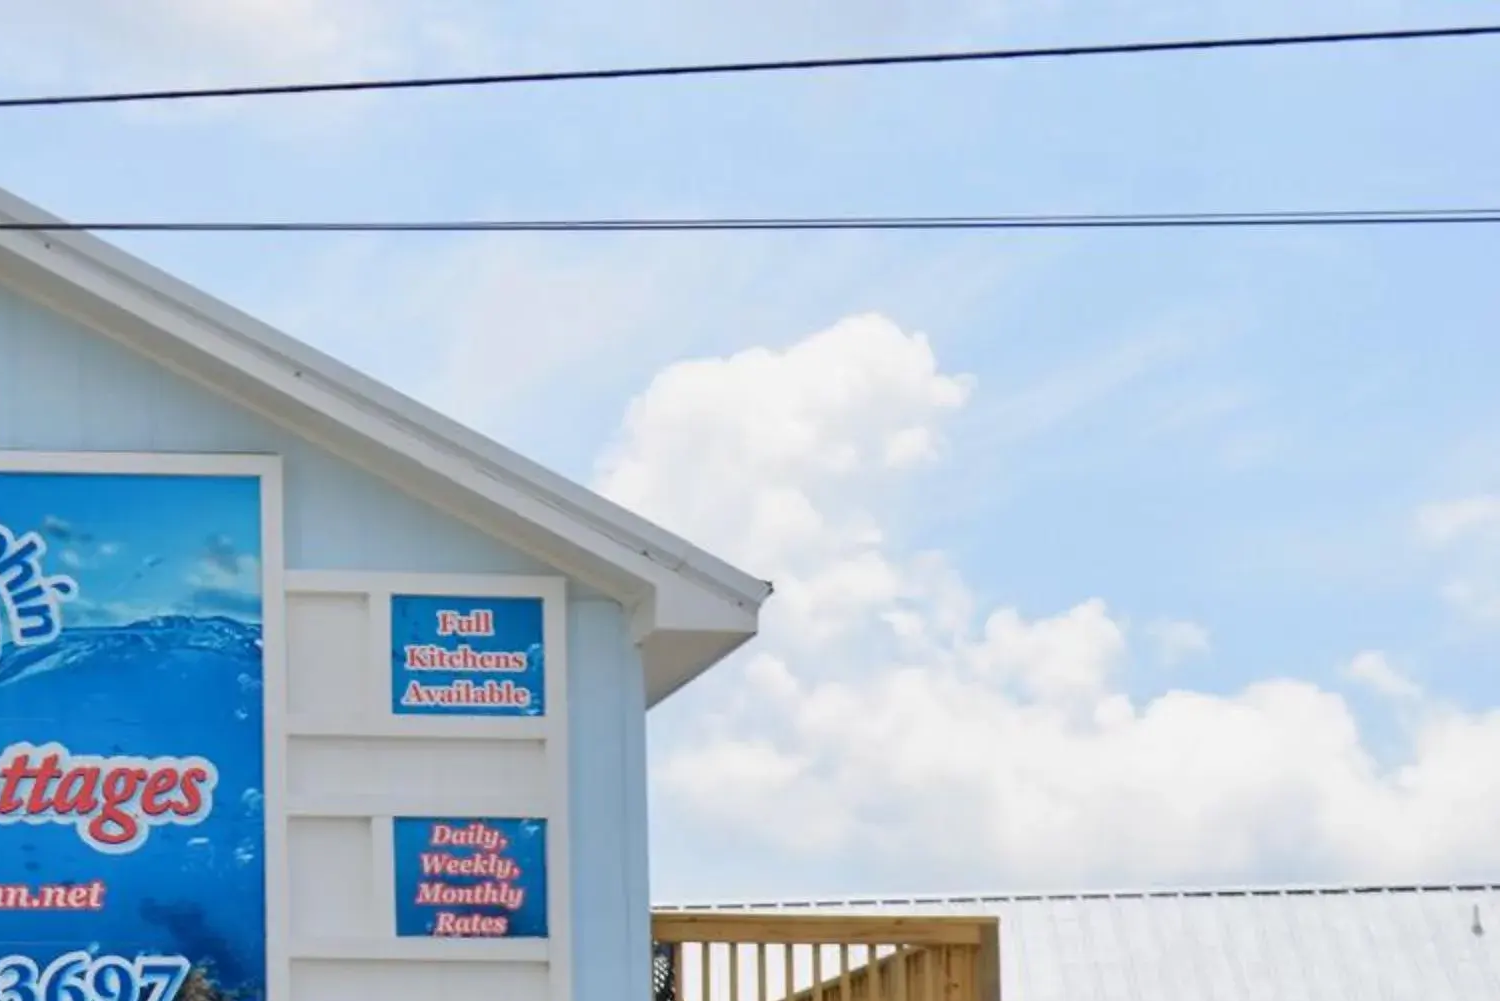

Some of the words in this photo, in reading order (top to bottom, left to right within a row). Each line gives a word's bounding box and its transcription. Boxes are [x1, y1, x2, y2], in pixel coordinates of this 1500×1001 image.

[438, 610, 494, 635] Full
[405, 645, 526, 670] Kitchens
[402, 680, 530, 706] Available
[416, 882, 524, 910] Monthly
[435, 912, 508, 935] Rates
